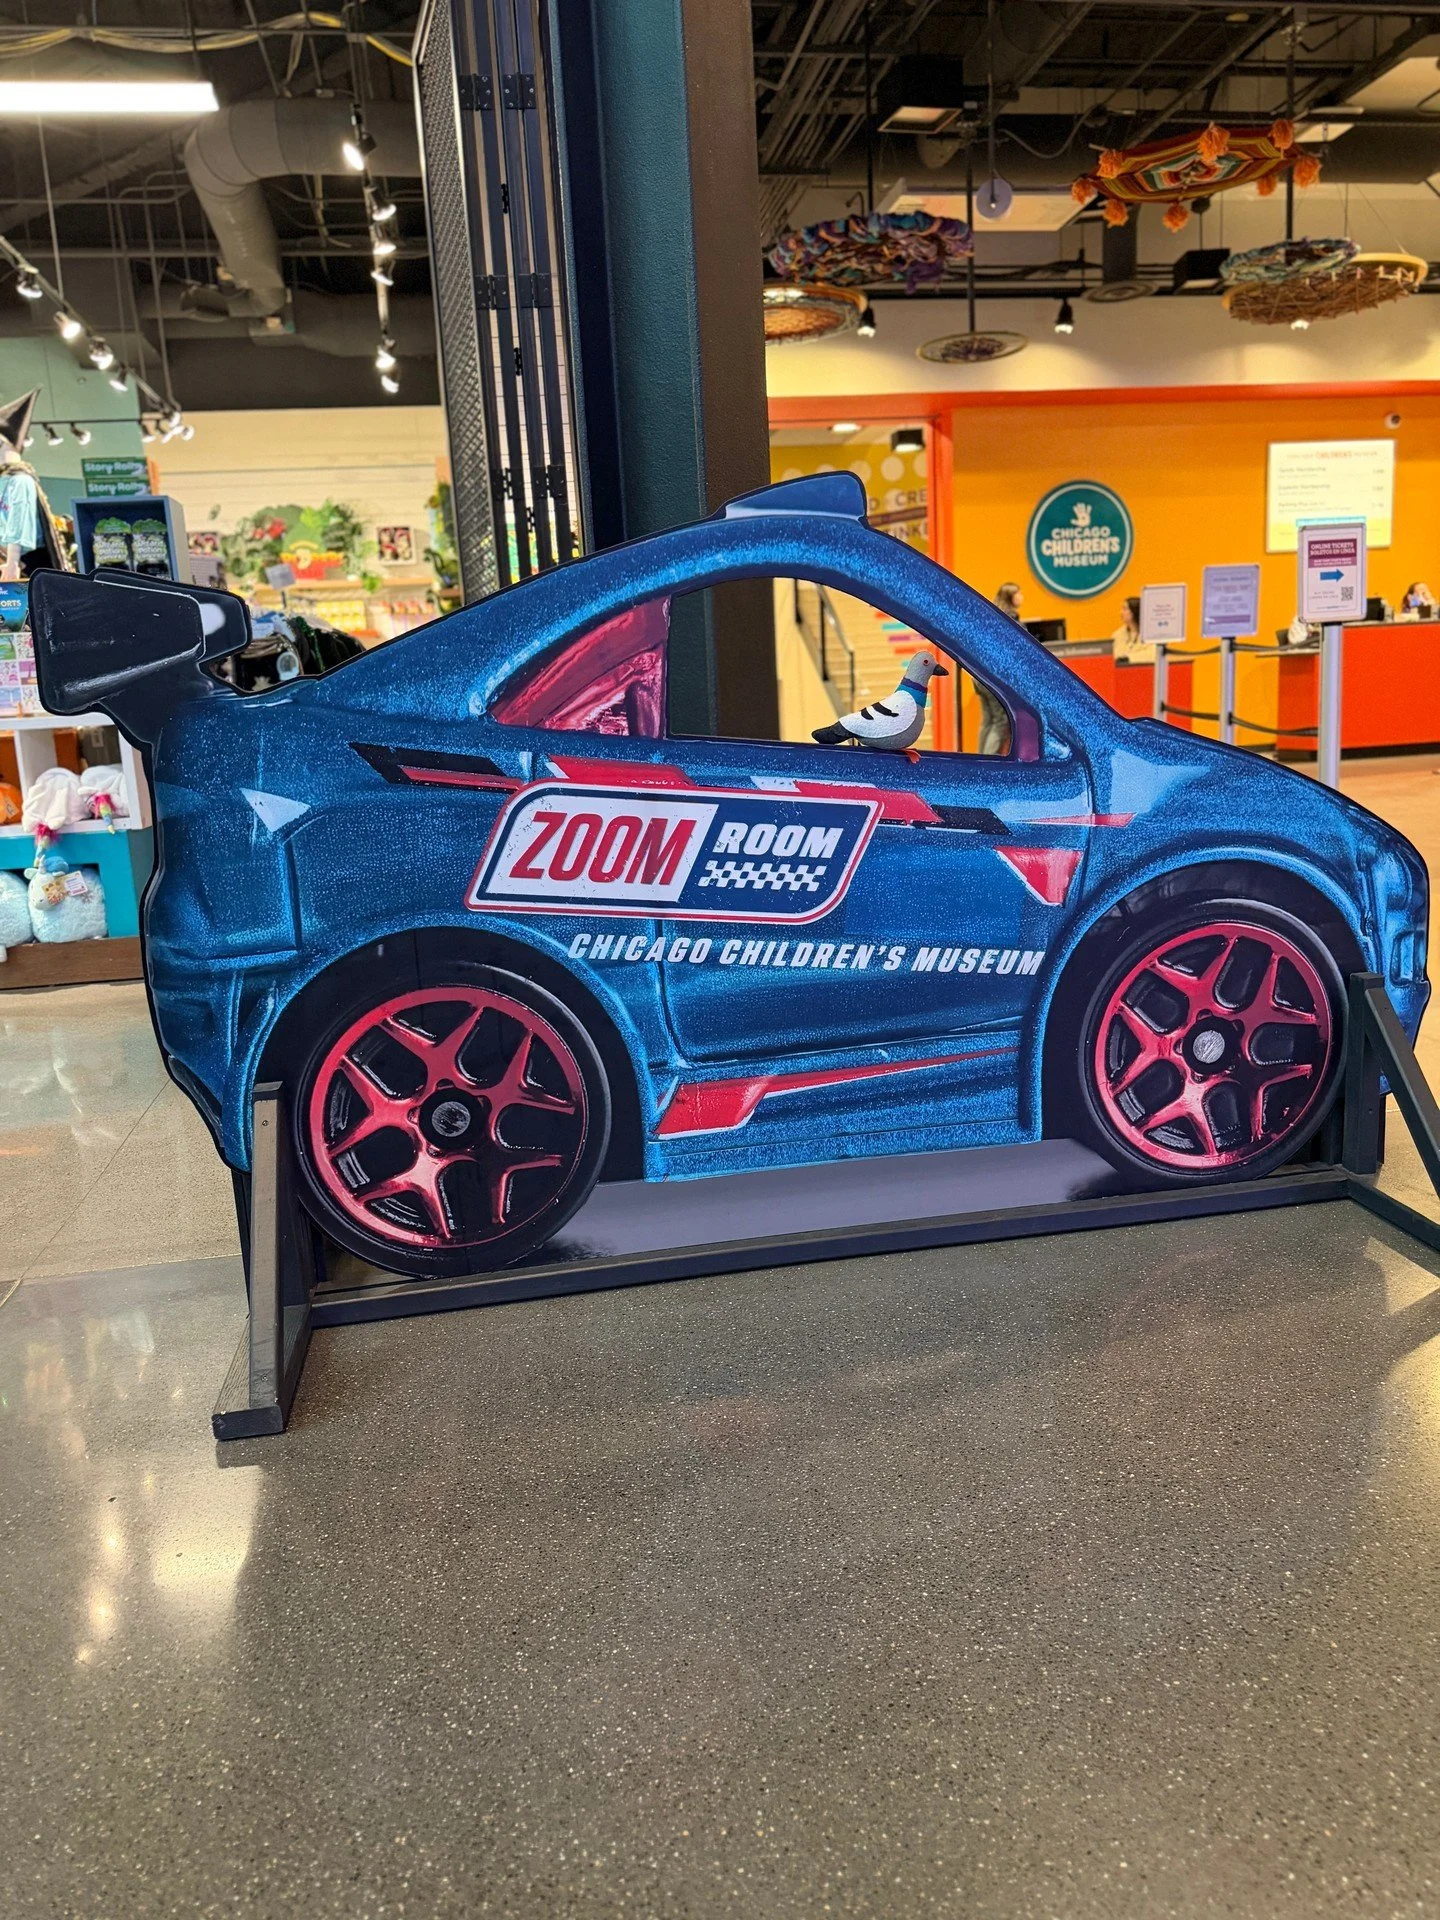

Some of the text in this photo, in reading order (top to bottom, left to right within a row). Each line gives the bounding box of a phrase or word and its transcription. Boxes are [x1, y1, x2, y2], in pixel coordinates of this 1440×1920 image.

[1051, 526, 1111, 540] CHICAGO
[1041, 537, 1120, 556] CHILDREN'S
[1310, 541, 1354, 551] ONLINE TICKETS
[1053, 554, 1108, 567] MUSEUM
[508, 810, 844, 886] ZOOM ROOM
[568, 933, 1045, 976] CHICAGO CHILDREN'S MUSEUM
